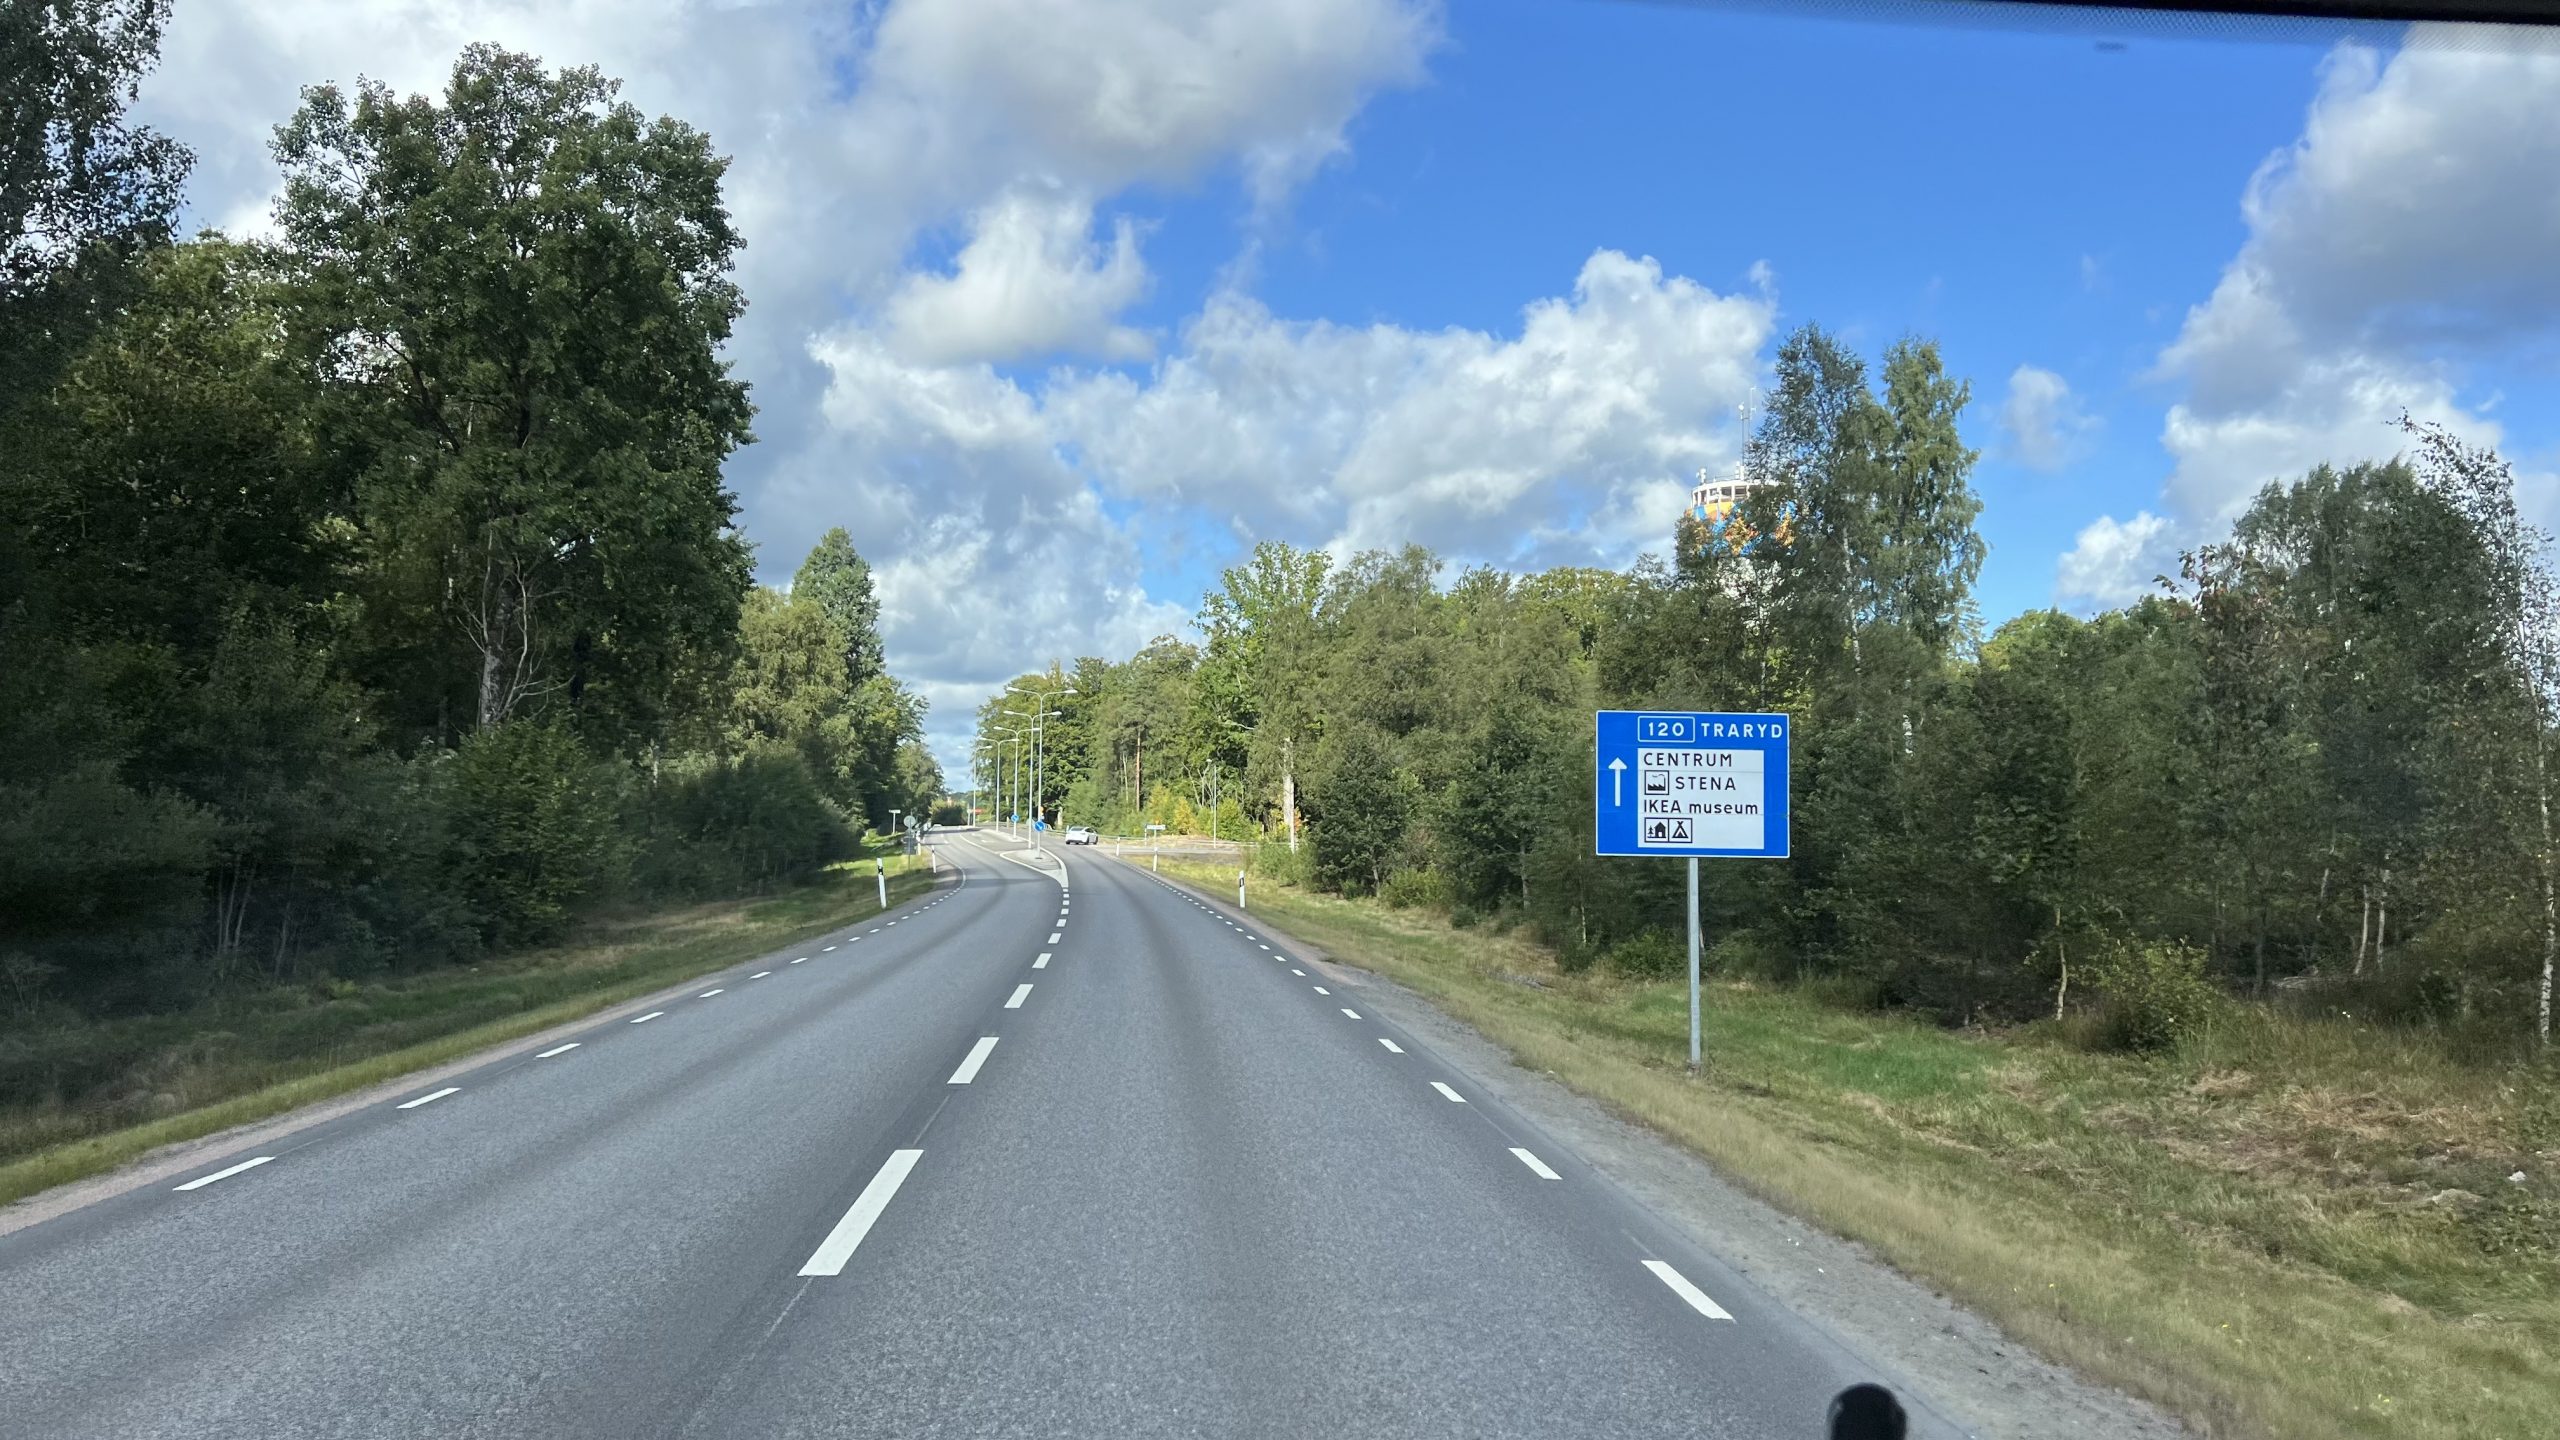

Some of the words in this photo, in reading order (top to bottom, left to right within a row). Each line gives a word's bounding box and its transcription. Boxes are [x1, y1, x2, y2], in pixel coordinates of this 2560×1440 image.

[1648, 722, 1685, 737] 120
[1701, 722, 1783, 739] TRARYD
[1643, 752, 1733, 767] CENTRUM
[1675, 776, 1736, 791] STENA
[1643, 799, 1681, 813] IKEA
[1689, 803, 1758, 814] museum
